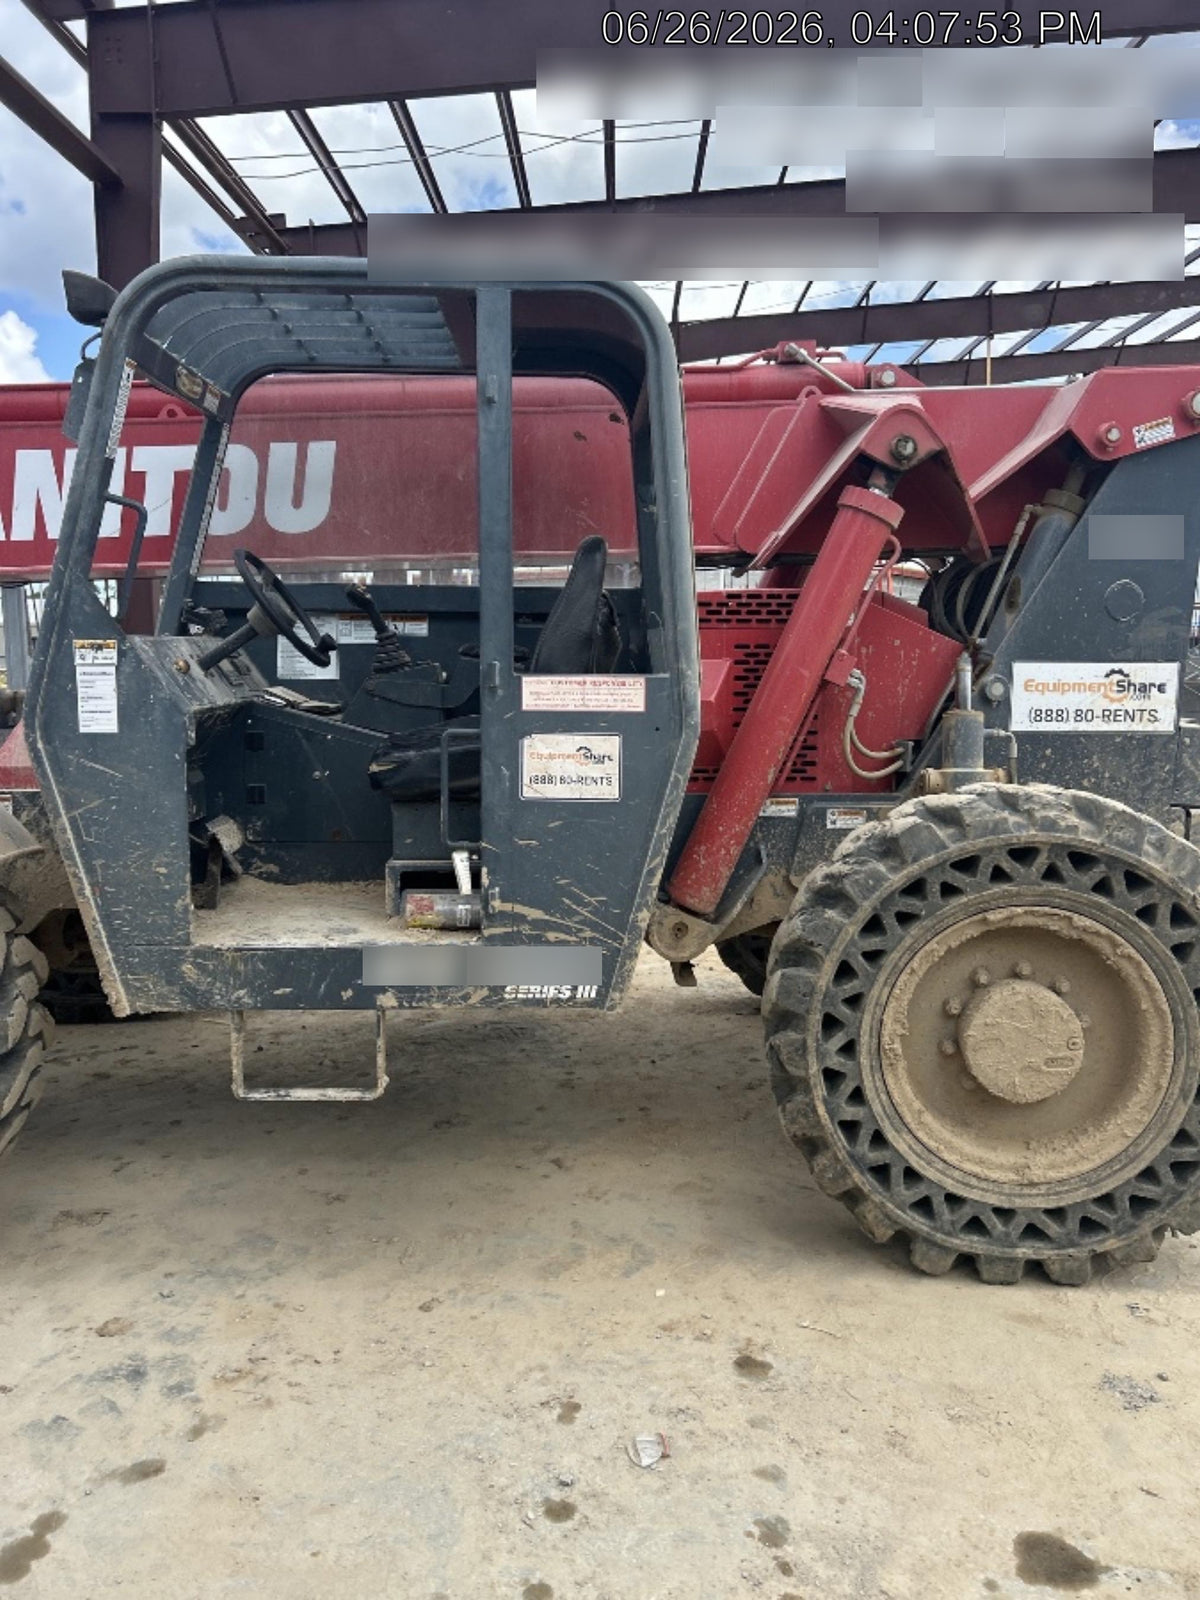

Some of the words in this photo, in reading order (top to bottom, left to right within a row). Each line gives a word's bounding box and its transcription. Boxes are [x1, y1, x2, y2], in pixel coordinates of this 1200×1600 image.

[0, 440, 337, 541] NITOU
[1029, 707, 1069, 724] (888)
[1073, 708, 1159, 723] 80-RENTS
[529, 774, 557, 787] (888)
[576, 984, 598, 999] III
